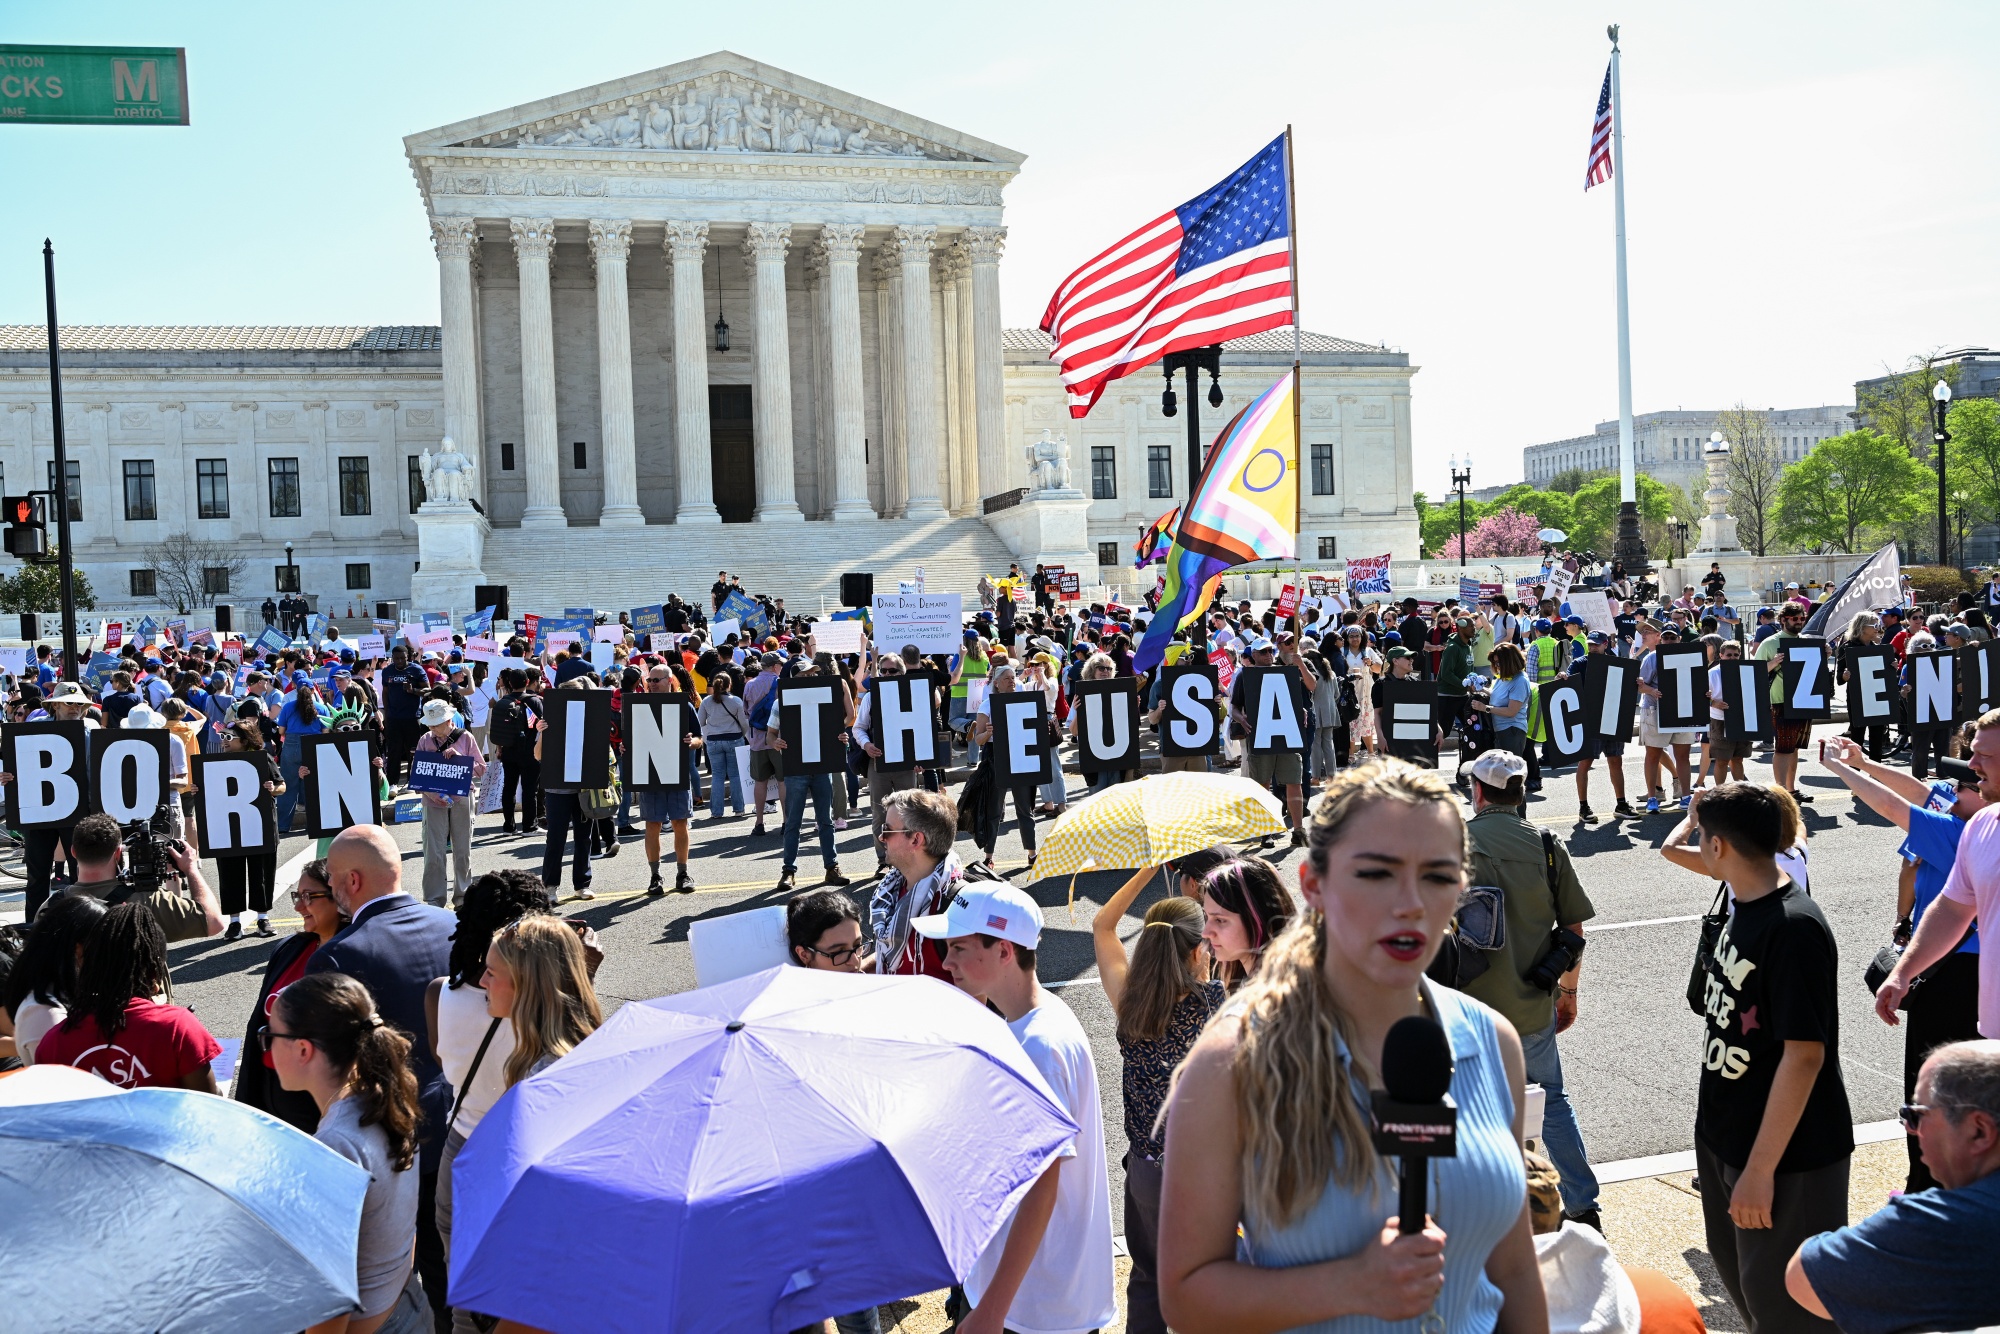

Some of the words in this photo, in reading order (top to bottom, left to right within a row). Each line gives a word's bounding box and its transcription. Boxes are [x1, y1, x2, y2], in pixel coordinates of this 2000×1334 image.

[1, 75, 64, 99] CKS
[0, 107, 26, 118] INE
[113, 105, 163, 119] metro
[619, 181, 673, 195] EQUAL
[679, 182, 742, 196] JUSTICE
[747, 183, 797, 198] UNDER
[803, 185, 835, 198] LAW
[1516, 576, 1536, 586] HANDS
[1554, 569, 1571, 581] DEFEND
[878, 598, 896, 608] DARK
[900, 598, 916, 608] DAYS
[920, 598, 948, 608] DEMAND
[1574, 599, 1605, 614] ICE
[886, 612, 909, 622] STRONG
[908, 624, 944, 632] GUARANTEES
[224, 648, 242, 656] BIRTH
[564, 700, 680, 786] IN
[782, 678, 1041, 774] THE
[1085, 673, 1302, 761] USA
[416, 760, 470, 774] BIRTHRIGHT.
[416, 768, 434, 776] OUR
[436, 770, 464, 780] RIGHT.
[1382, 1122, 1453, 1136] FRONTLINES
